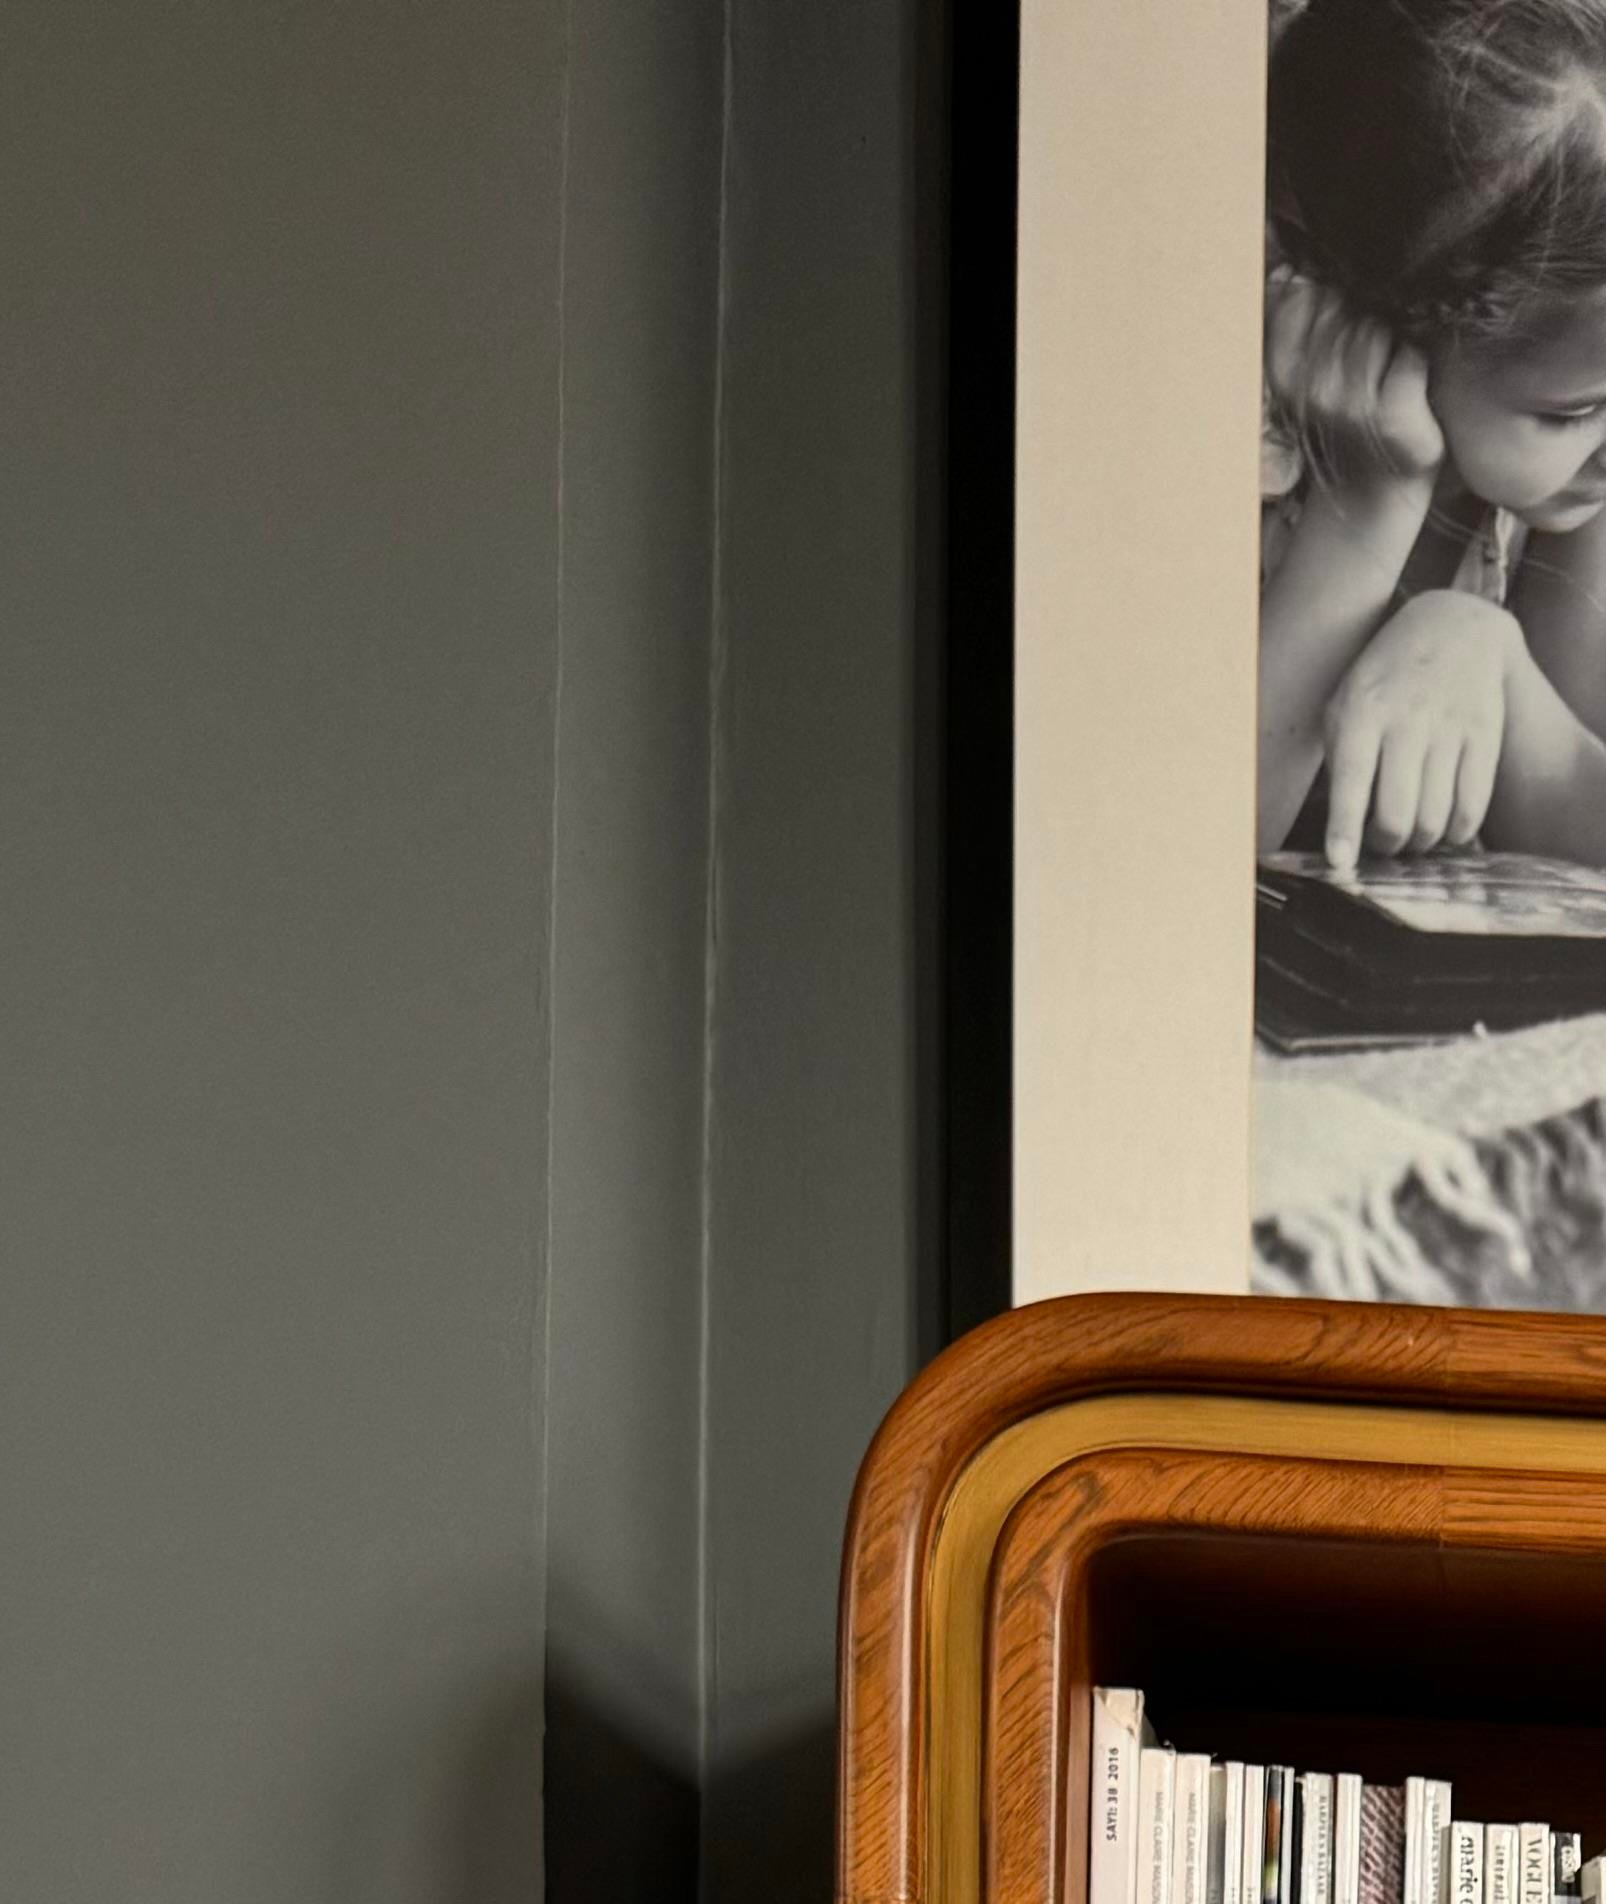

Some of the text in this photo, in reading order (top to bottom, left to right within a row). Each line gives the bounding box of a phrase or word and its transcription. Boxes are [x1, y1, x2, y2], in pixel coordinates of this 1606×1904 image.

[1108, 1746, 1119, 1781] 2016
[1459, 1836, 1479, 1894] marie
[1525, 1838, 1543, 1904] VOGUE
